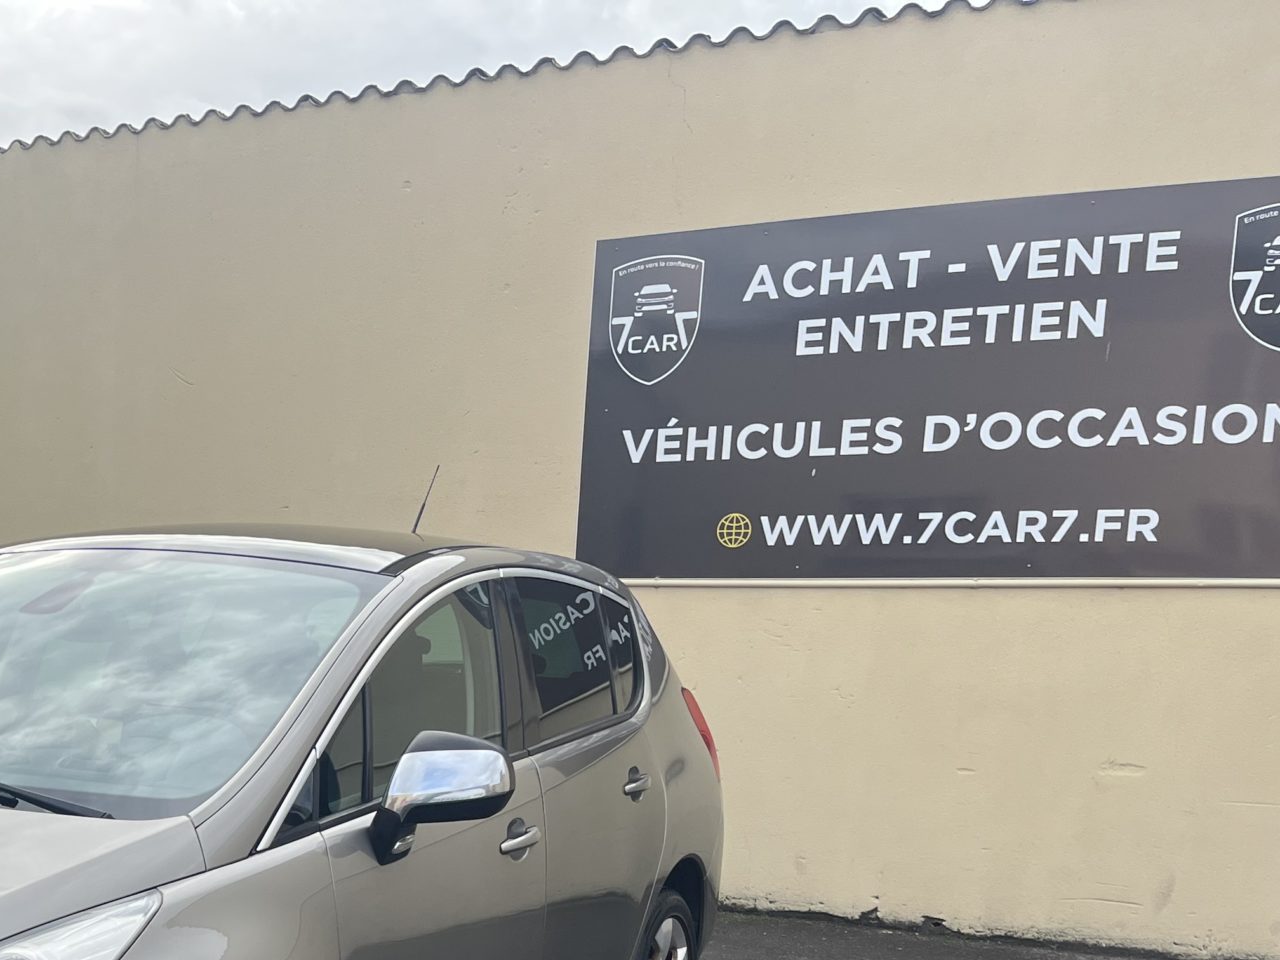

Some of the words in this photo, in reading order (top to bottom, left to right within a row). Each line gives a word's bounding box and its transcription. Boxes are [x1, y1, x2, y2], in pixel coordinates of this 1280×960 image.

[1244, 216, 1255, 224] En
[1256, 209, 1279, 220] route
[742, 250, 930, 302] ACHAT
[987, 231, 1181, 281] VENTE
[795, 298, 1107, 356] ENTRETIEN
[622, 417, 903, 463] VÉHICULES
[760, 508, 1159, 546] WWW.7CAR7.FR
